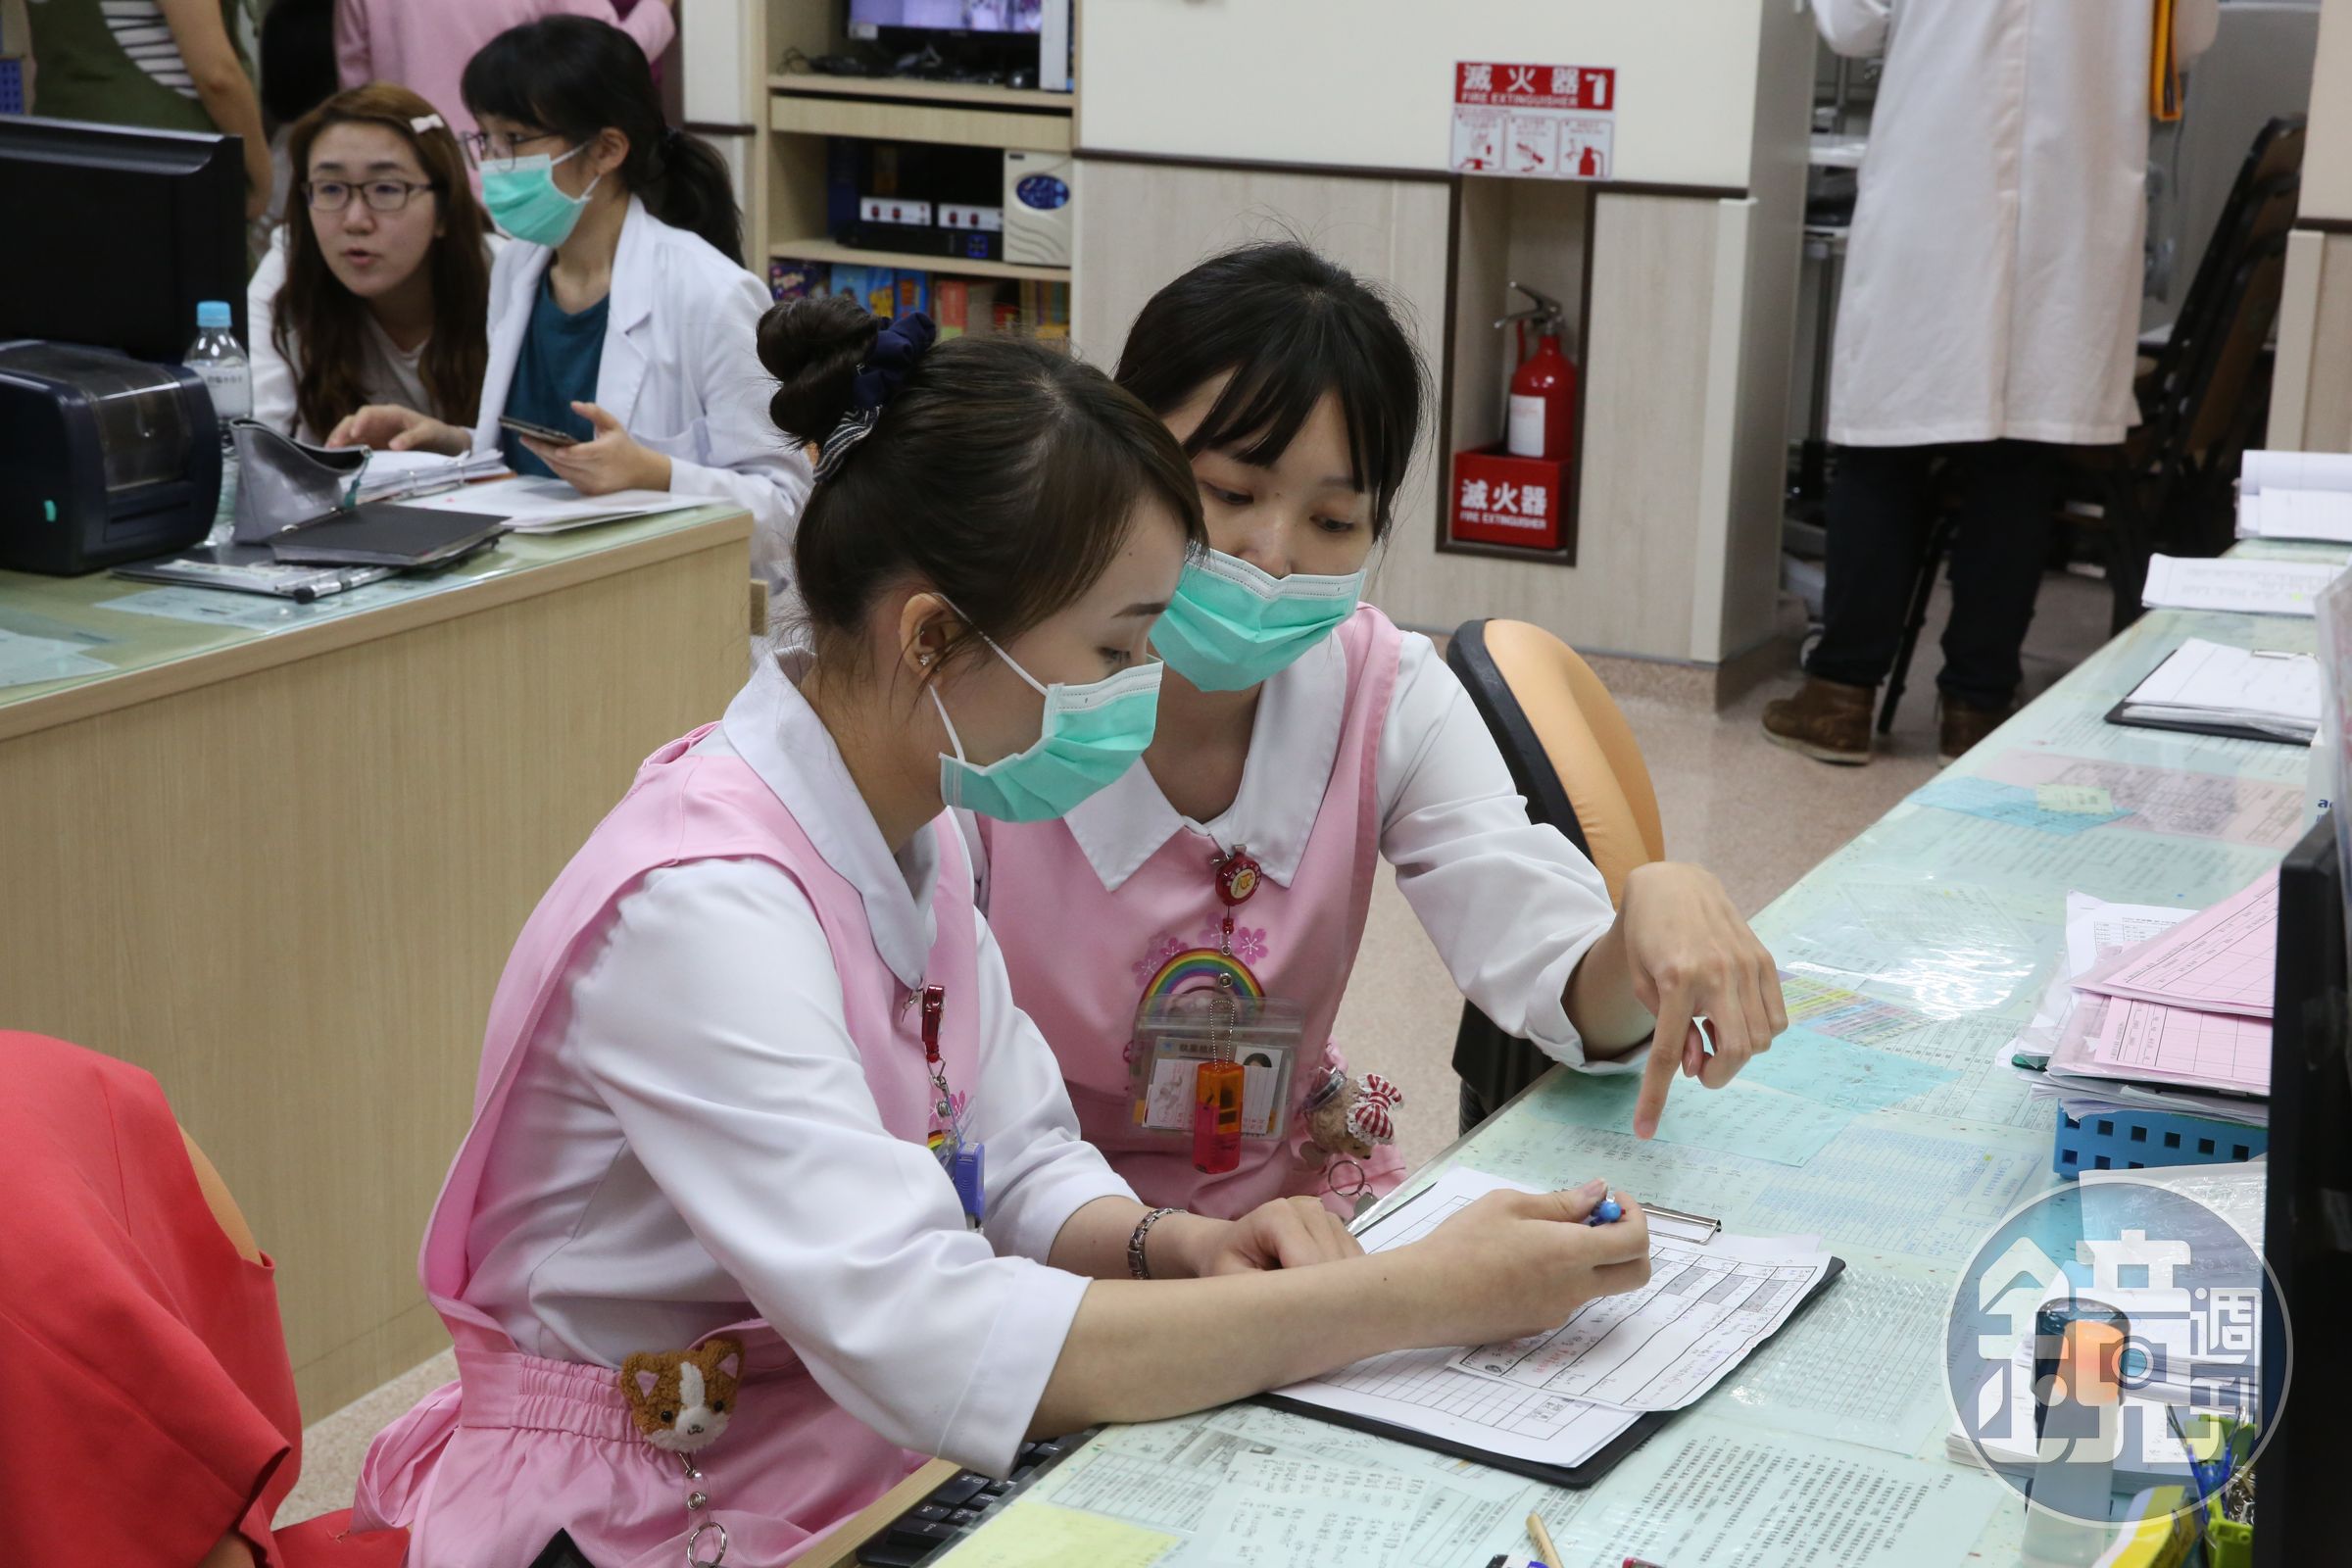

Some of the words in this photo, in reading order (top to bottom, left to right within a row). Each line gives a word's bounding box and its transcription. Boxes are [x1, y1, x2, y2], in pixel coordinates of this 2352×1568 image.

[1463, 64, 1580, 95] 滅火器
[1460, 478, 1547, 515] 滅火器
[1460, 510, 1480, 522] FIRE
[1482, 513, 1546, 529] EXTINGUISHER
